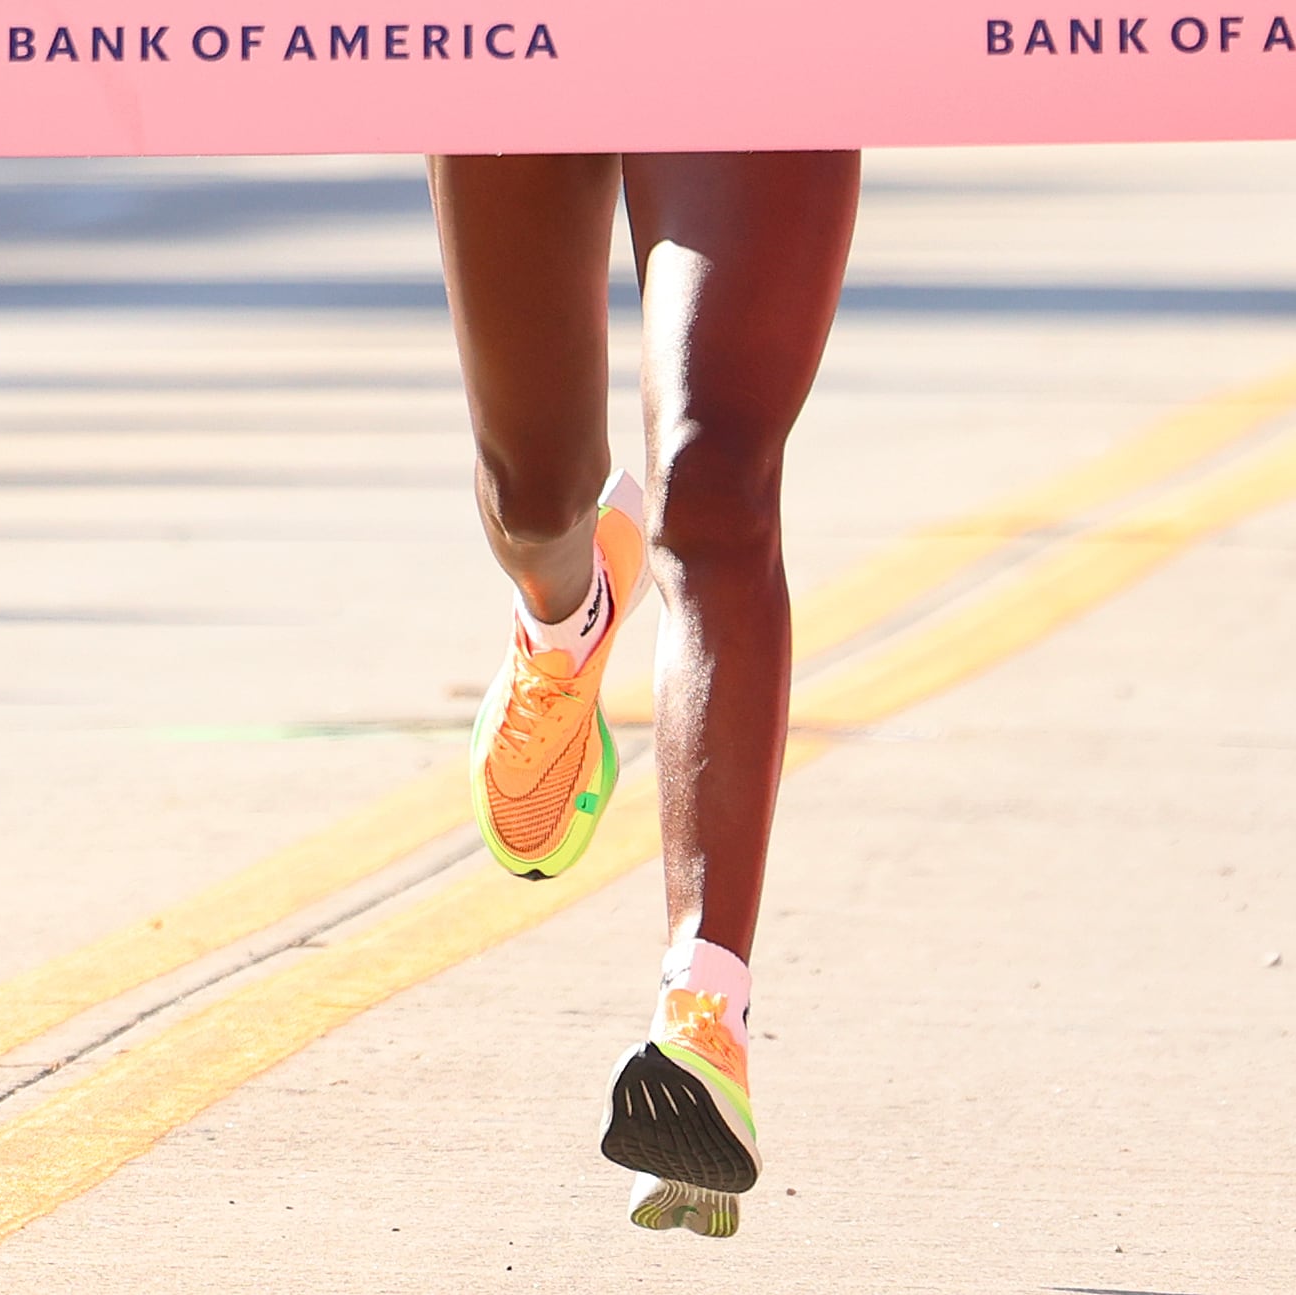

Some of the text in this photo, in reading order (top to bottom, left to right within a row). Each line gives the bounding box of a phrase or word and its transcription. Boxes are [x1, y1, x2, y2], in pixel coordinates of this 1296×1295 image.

[8, 23, 558, 62] BANK OF AMERICA
[986, 18, 1146, 55] BANK
[1171, 16, 1243, 54] OF
